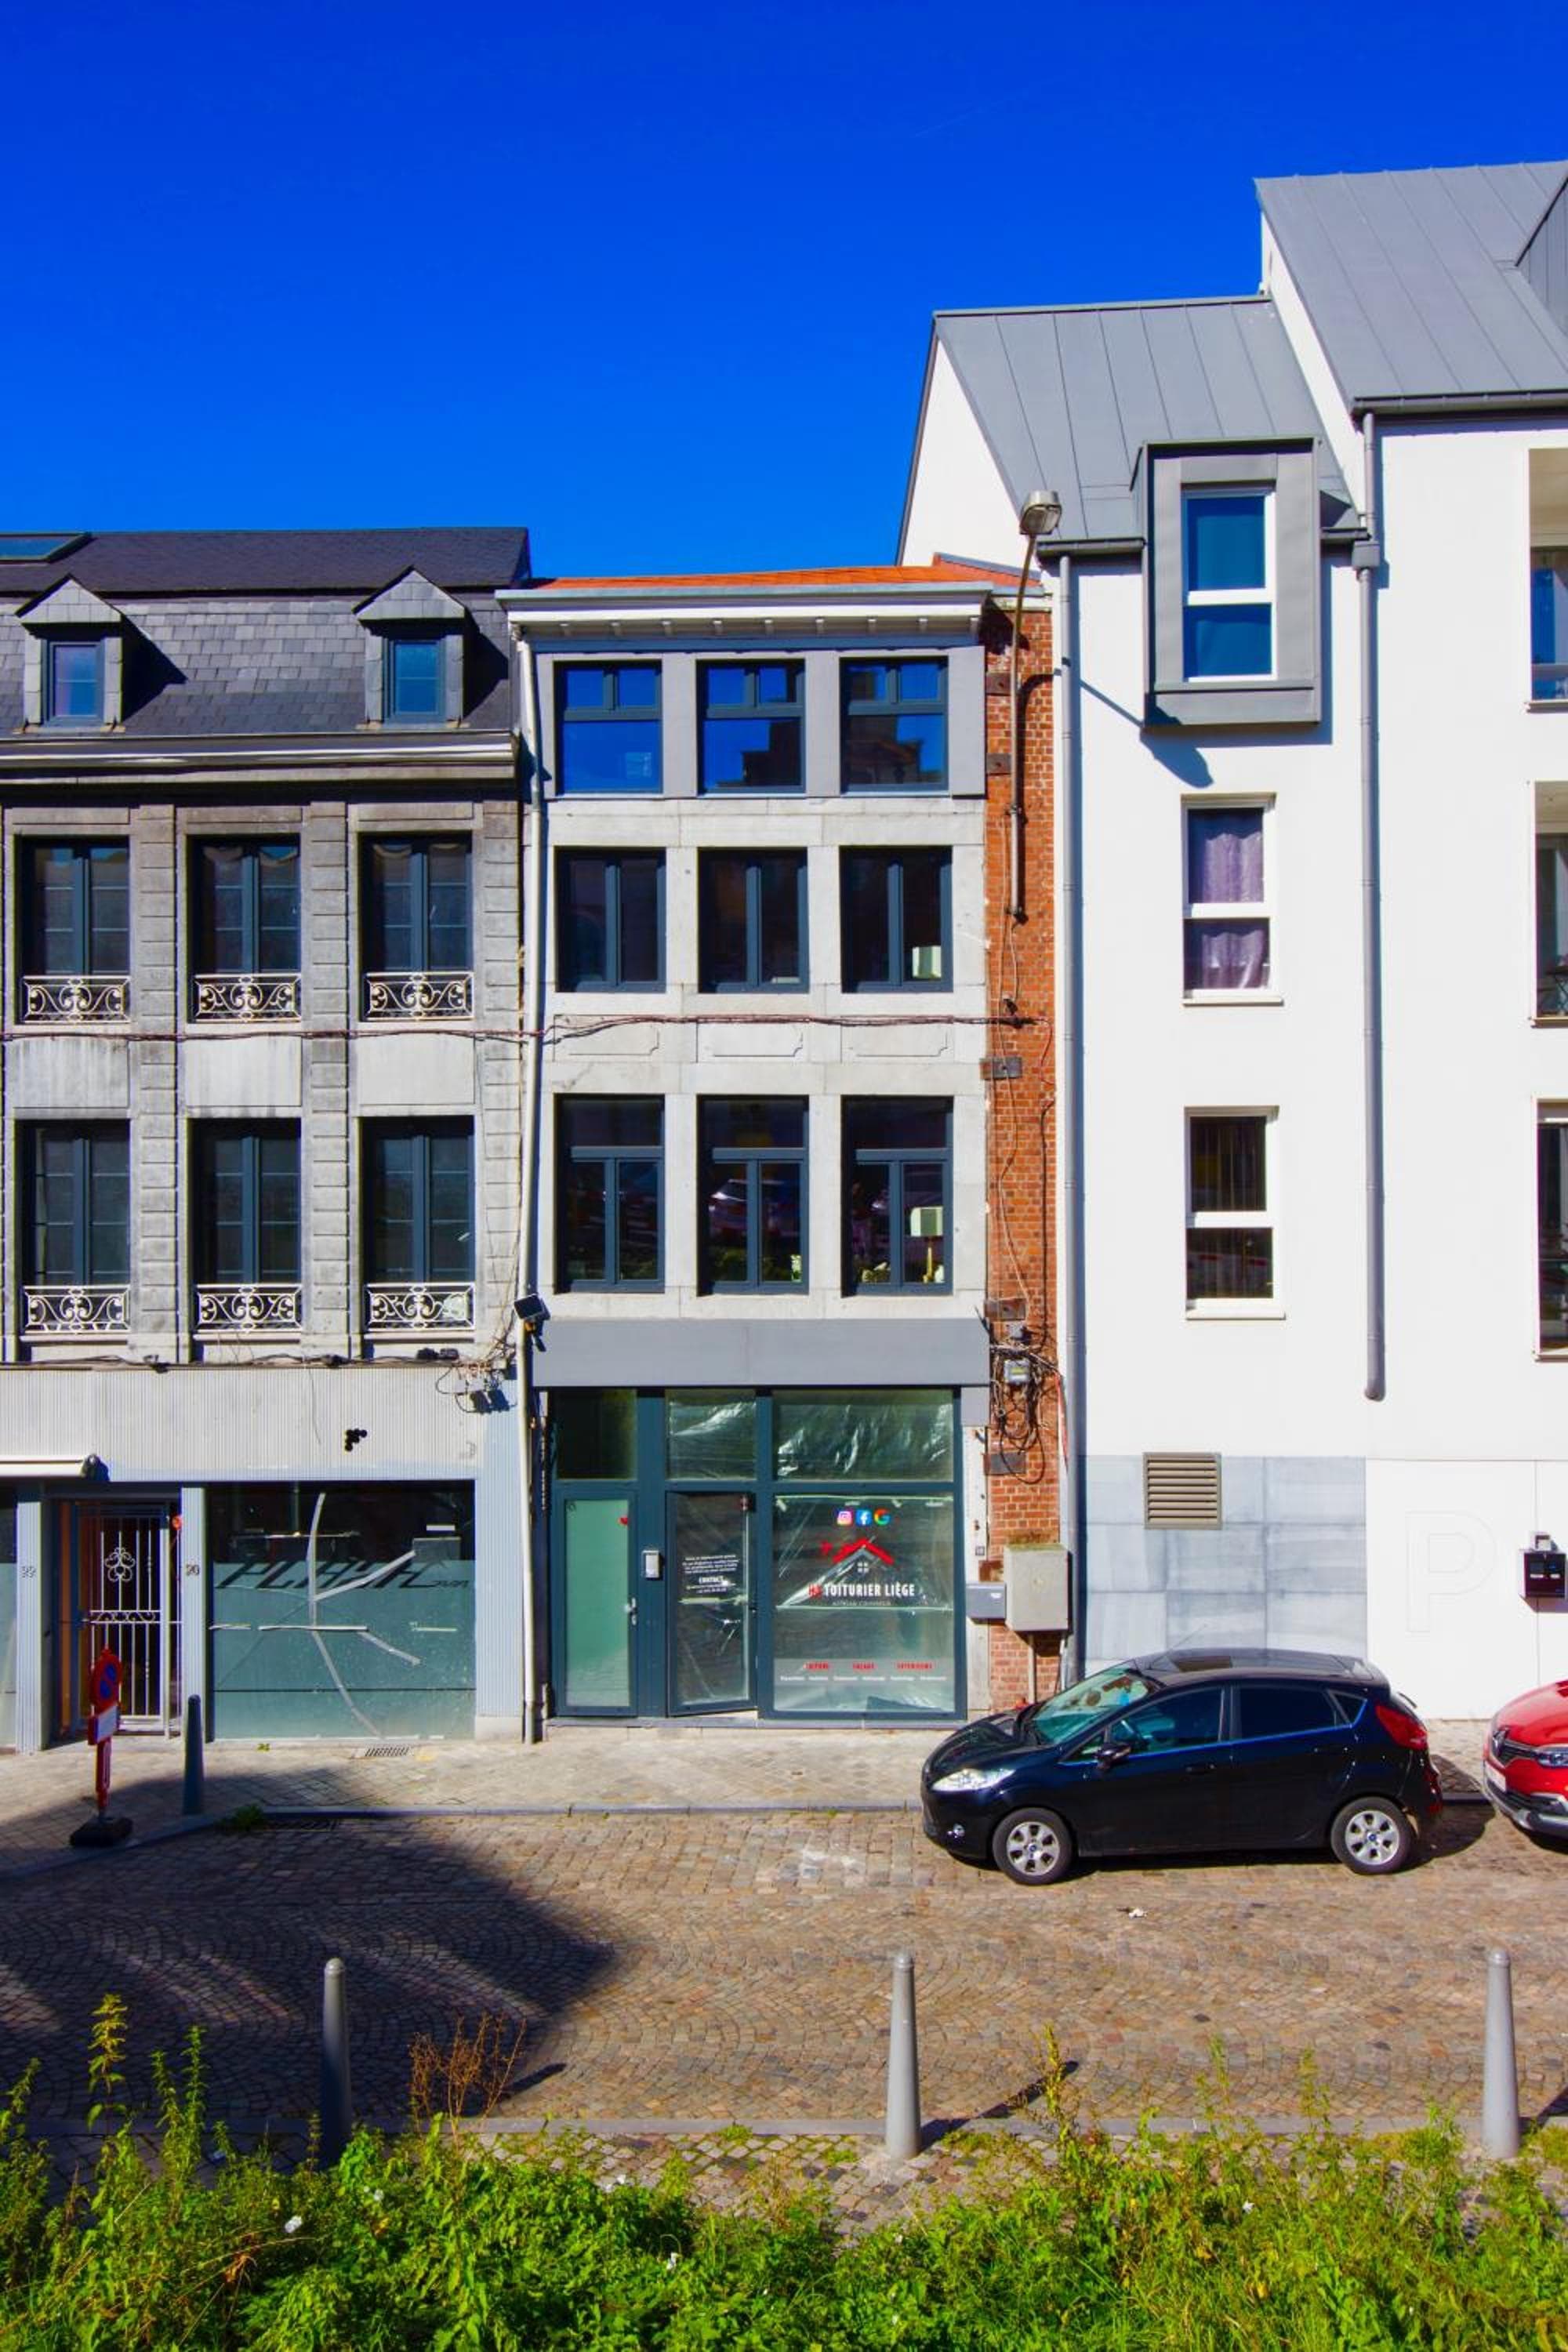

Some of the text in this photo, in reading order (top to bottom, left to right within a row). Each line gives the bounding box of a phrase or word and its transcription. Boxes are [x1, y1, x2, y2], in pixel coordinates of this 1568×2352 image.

[824, 1583, 881, 1597] TOITURIER
[884, 1581, 915, 1597] LIÈGE
[1406, 1511, 1496, 1632] P
